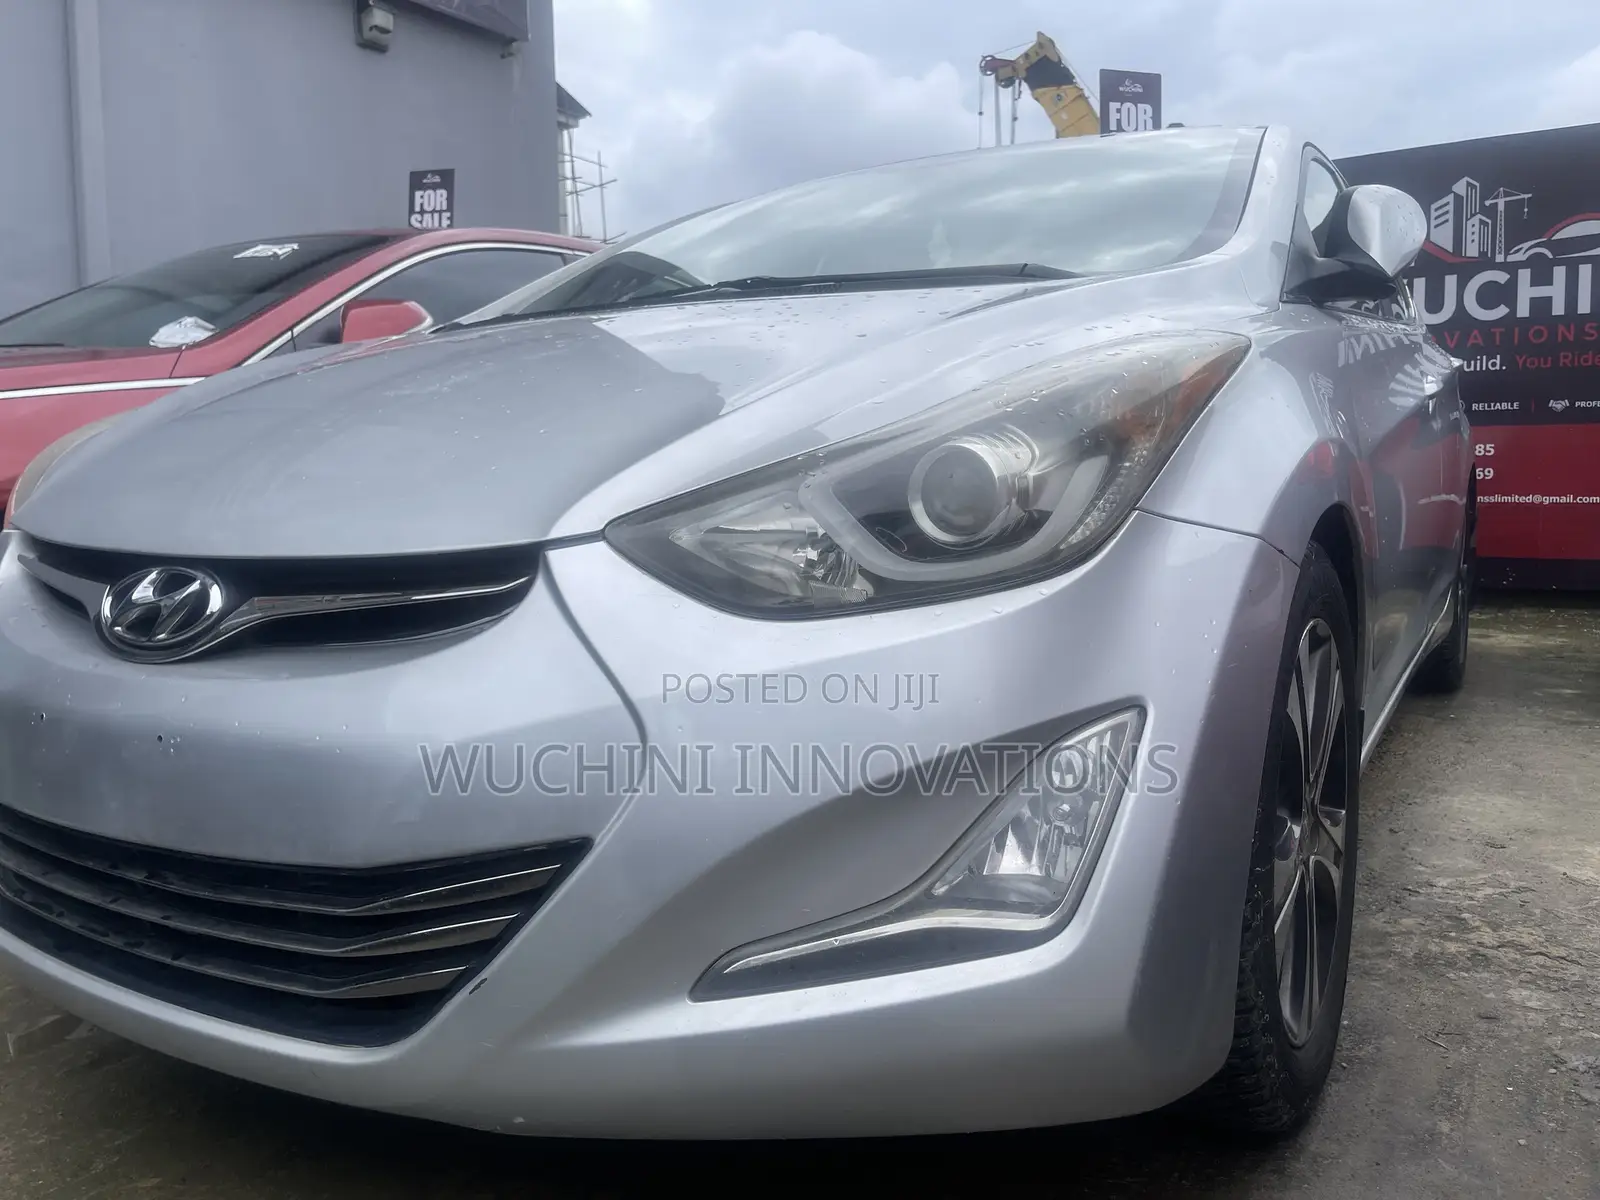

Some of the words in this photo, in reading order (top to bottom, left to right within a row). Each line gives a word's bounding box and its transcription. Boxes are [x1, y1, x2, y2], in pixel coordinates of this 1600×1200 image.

[1109, 101, 1154, 132] FOR
[414, 189, 447, 212] FOR
[1404, 264, 1592, 325] UCHI
[1432, 322, 1600, 349] VATIONS
[1463, 355, 1507, 372] uild.
[1515, 353, 1552, 369] You
[1471, 402, 1520, 411] RELIABLE
